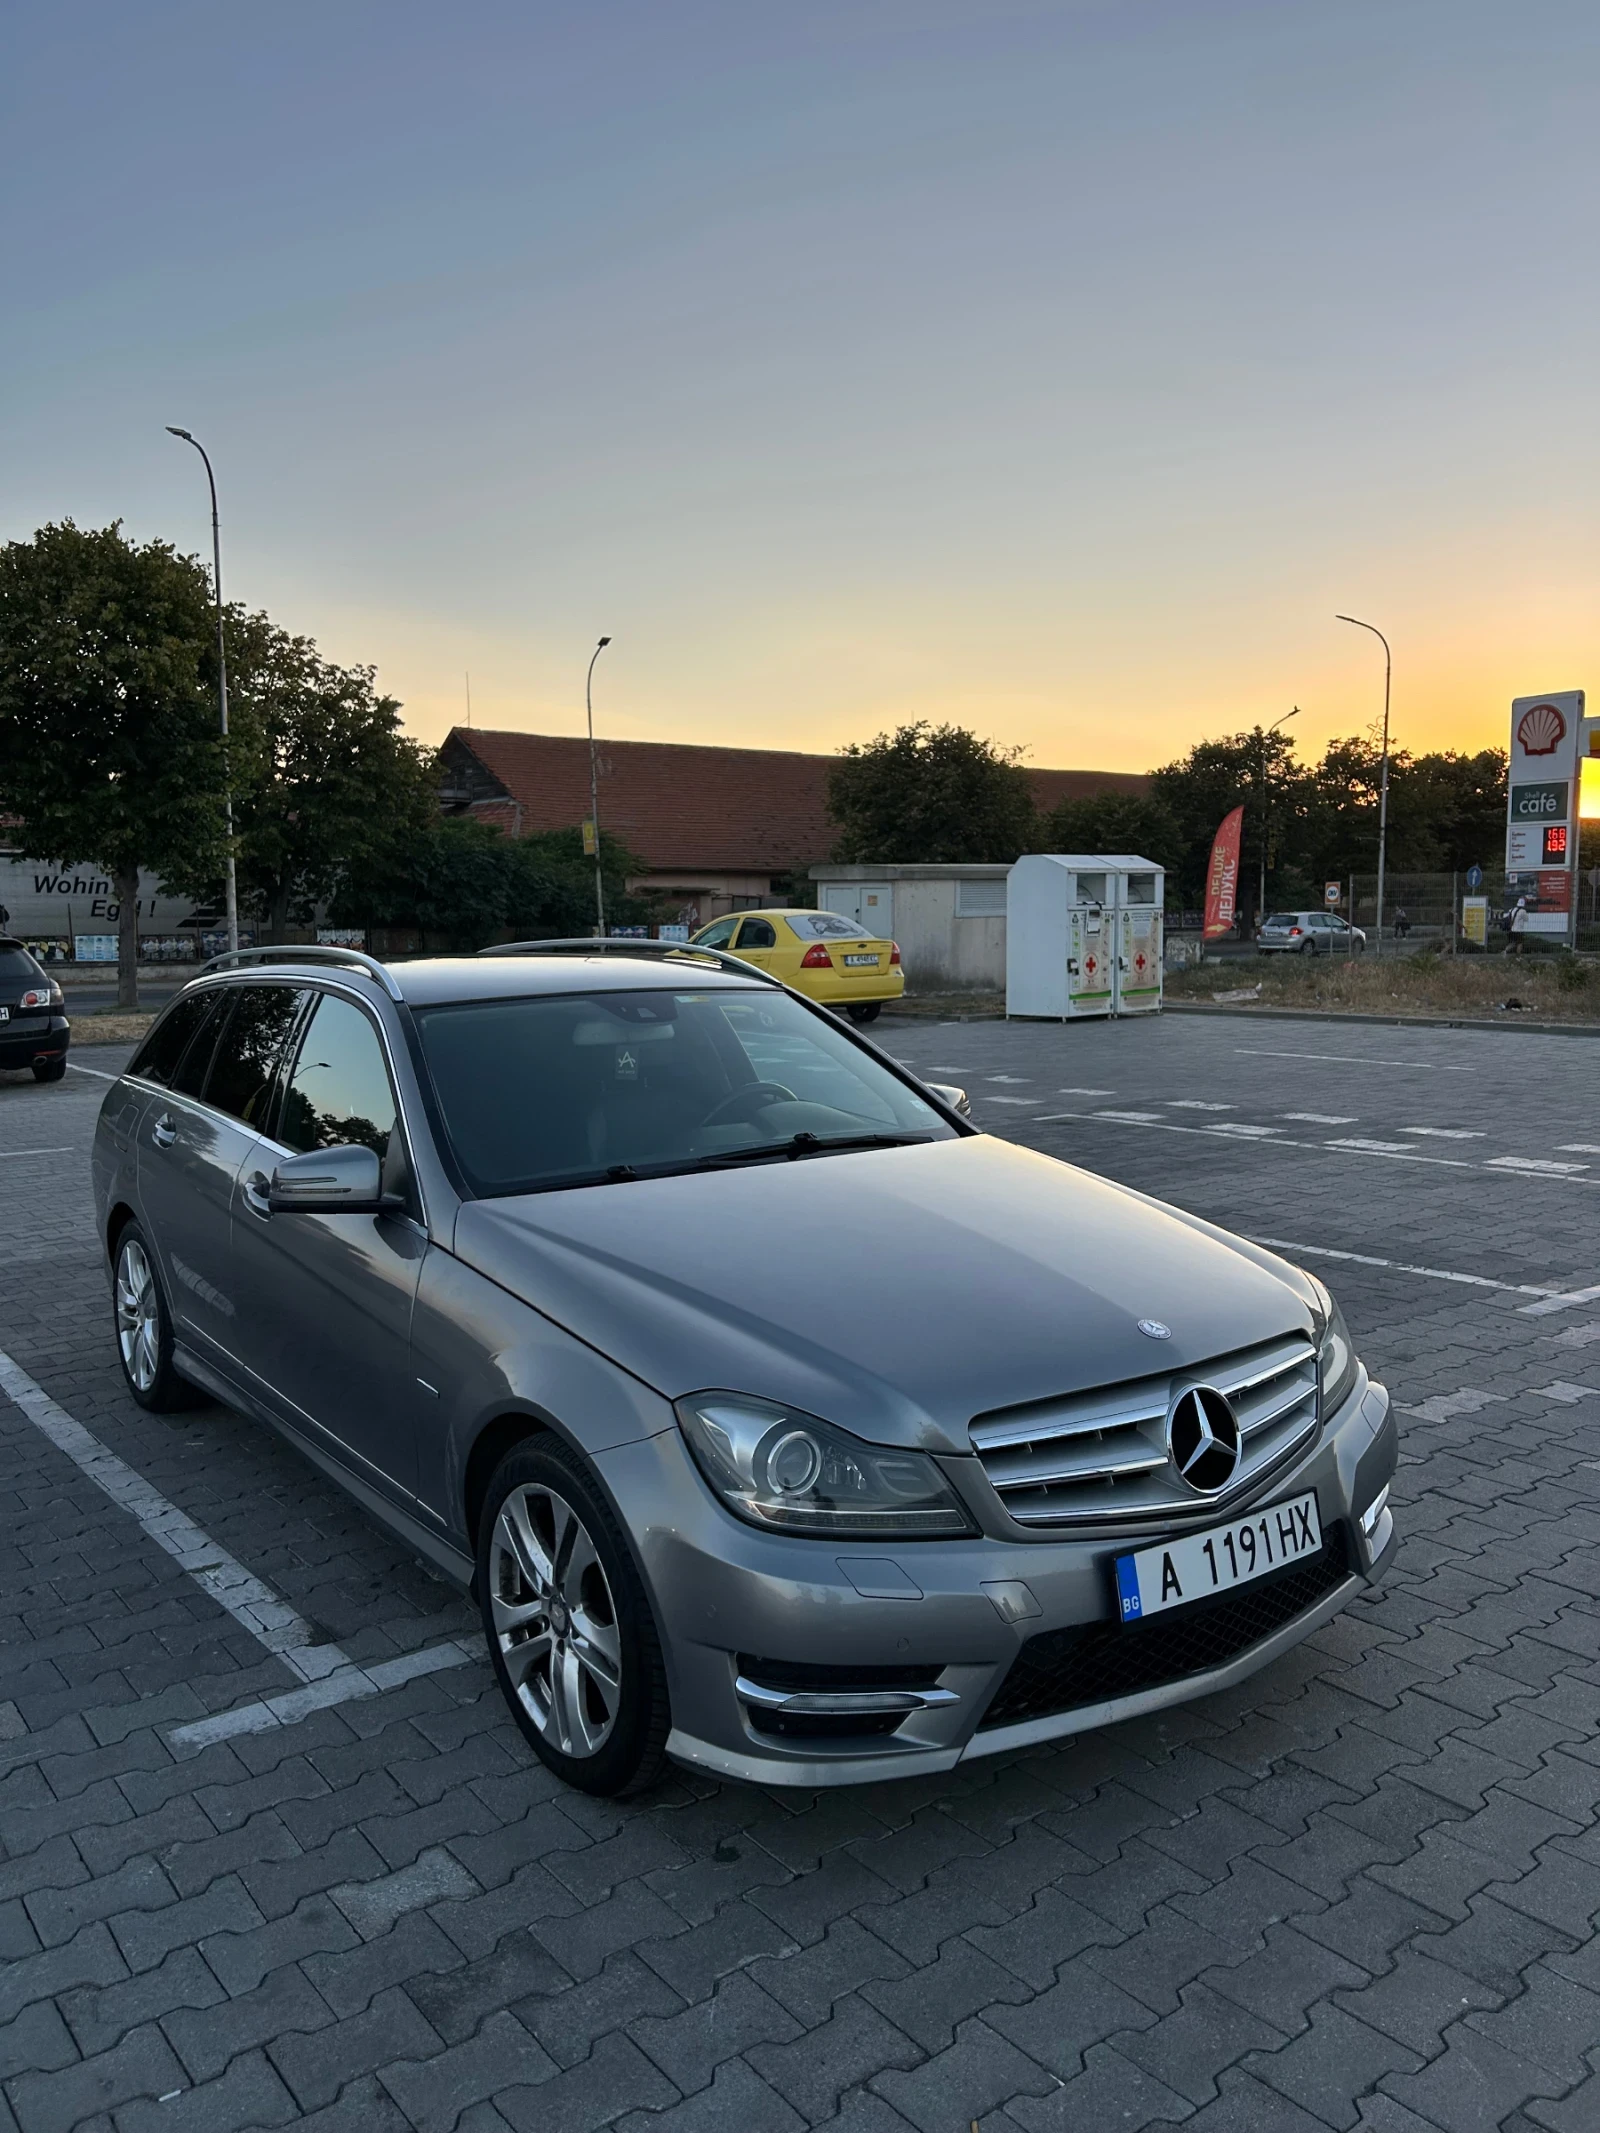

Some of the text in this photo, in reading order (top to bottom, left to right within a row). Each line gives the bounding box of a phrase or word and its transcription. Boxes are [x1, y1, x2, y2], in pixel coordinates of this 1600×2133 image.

[1519, 792, 1557, 814] café
[34, 875, 109, 894] Wohin
[91, 899, 142, 922] Egl
[1161, 1551, 1183, 1602] A
[1122, 1595, 1140, 1613] BG
